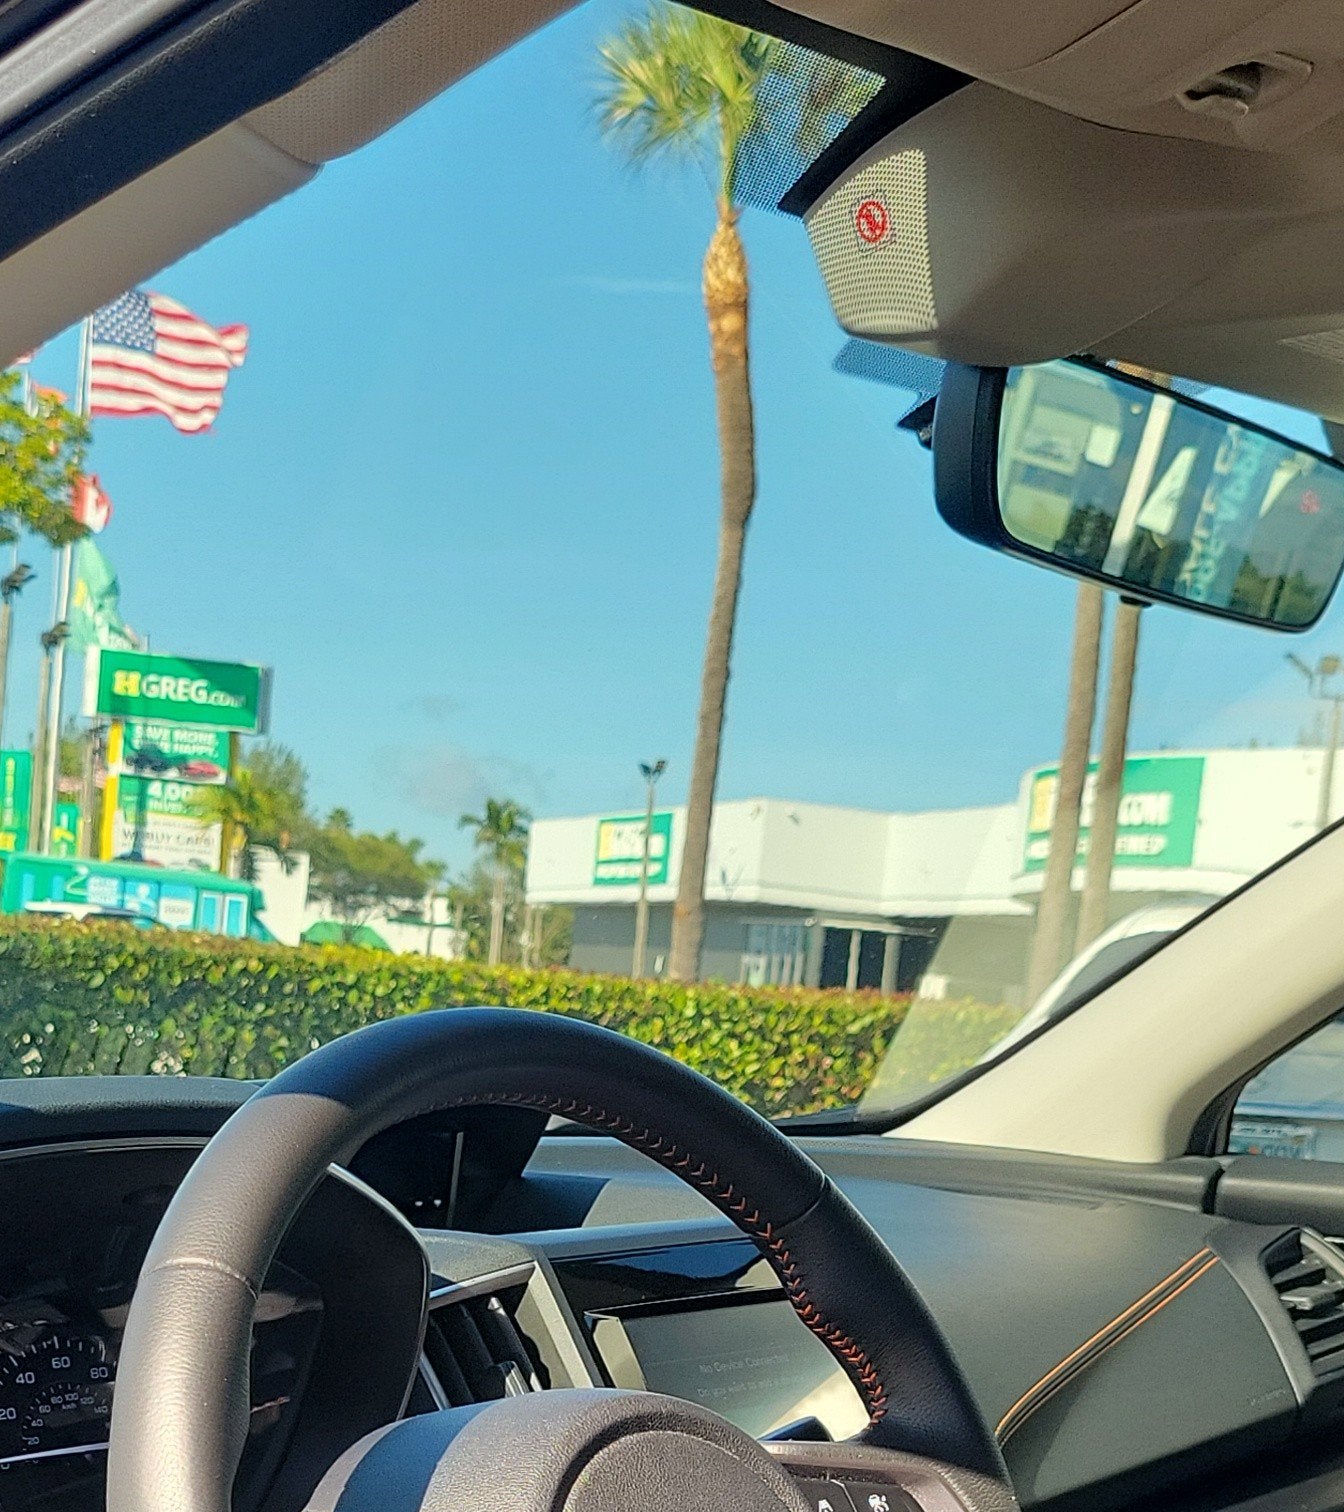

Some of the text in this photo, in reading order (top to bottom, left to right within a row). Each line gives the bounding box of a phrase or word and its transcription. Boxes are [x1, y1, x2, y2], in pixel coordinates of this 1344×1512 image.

[51, 1355, 71, 1369] 60
[15, 1371, 36, 1384] 40
[90, 1366, 109, 1379] 80
